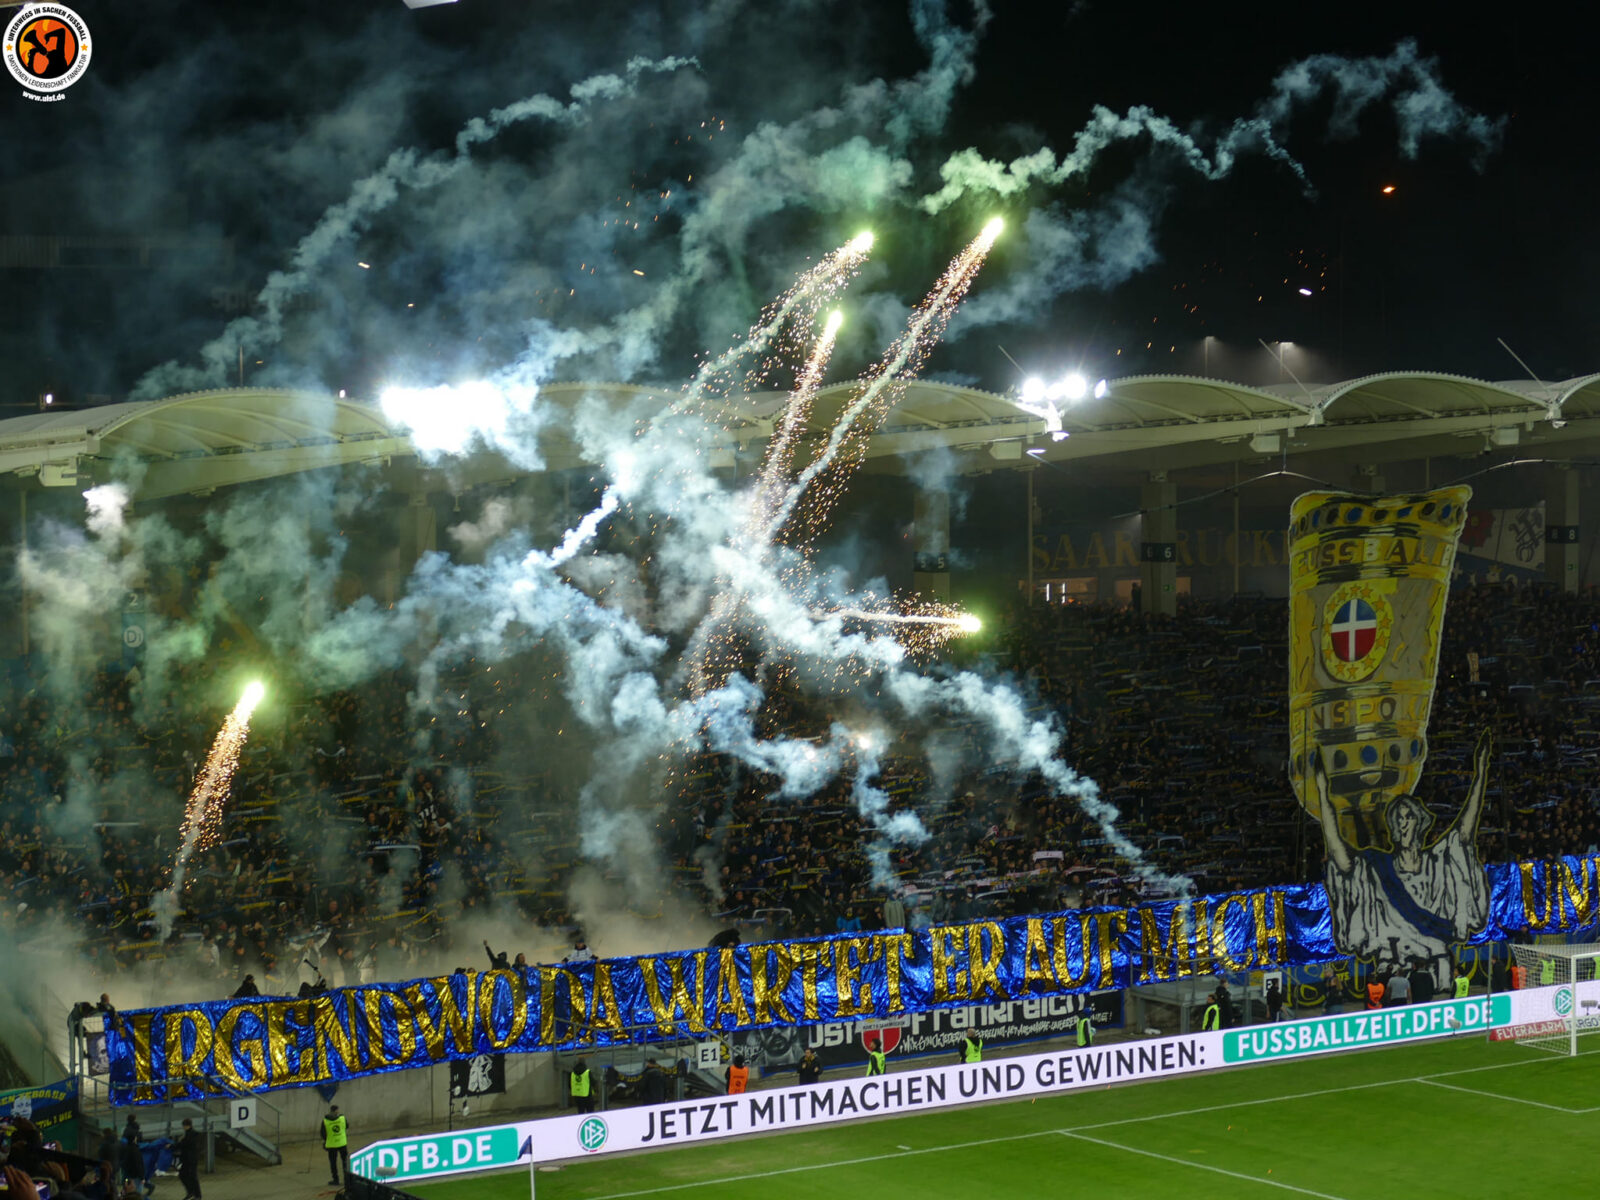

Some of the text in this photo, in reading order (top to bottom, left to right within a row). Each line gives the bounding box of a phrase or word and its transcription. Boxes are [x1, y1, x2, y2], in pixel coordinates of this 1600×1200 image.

[1568, 529, 1576, 540] 8
[1164, 547, 1172, 560] 6
[937, 556, 945, 569] 5
[128, 593, 138, 608] 2
[637, 932, 915, 1035] WARTET
[928, 920, 1011, 1004] ER
[1020, 911, 1128, 995] AUF
[1139, 890, 1287, 982] MICH
[1518, 857, 1600, 929] UN
[1237, 1000, 1494, 1057] FUSSBALLZEIT.DFBDE
[1496, 1020, 1565, 1041] FLYERALARM
[701, 1048, 718, 1062] E1
[641, 1101, 738, 1142] JETZT
[749, 1072, 946, 1127] MITMACHEN
[958, 1063, 1025, 1098] UND
[1035, 1038, 1206, 1088] GEWINNEN:
[237, 1106, 249, 1121] D
